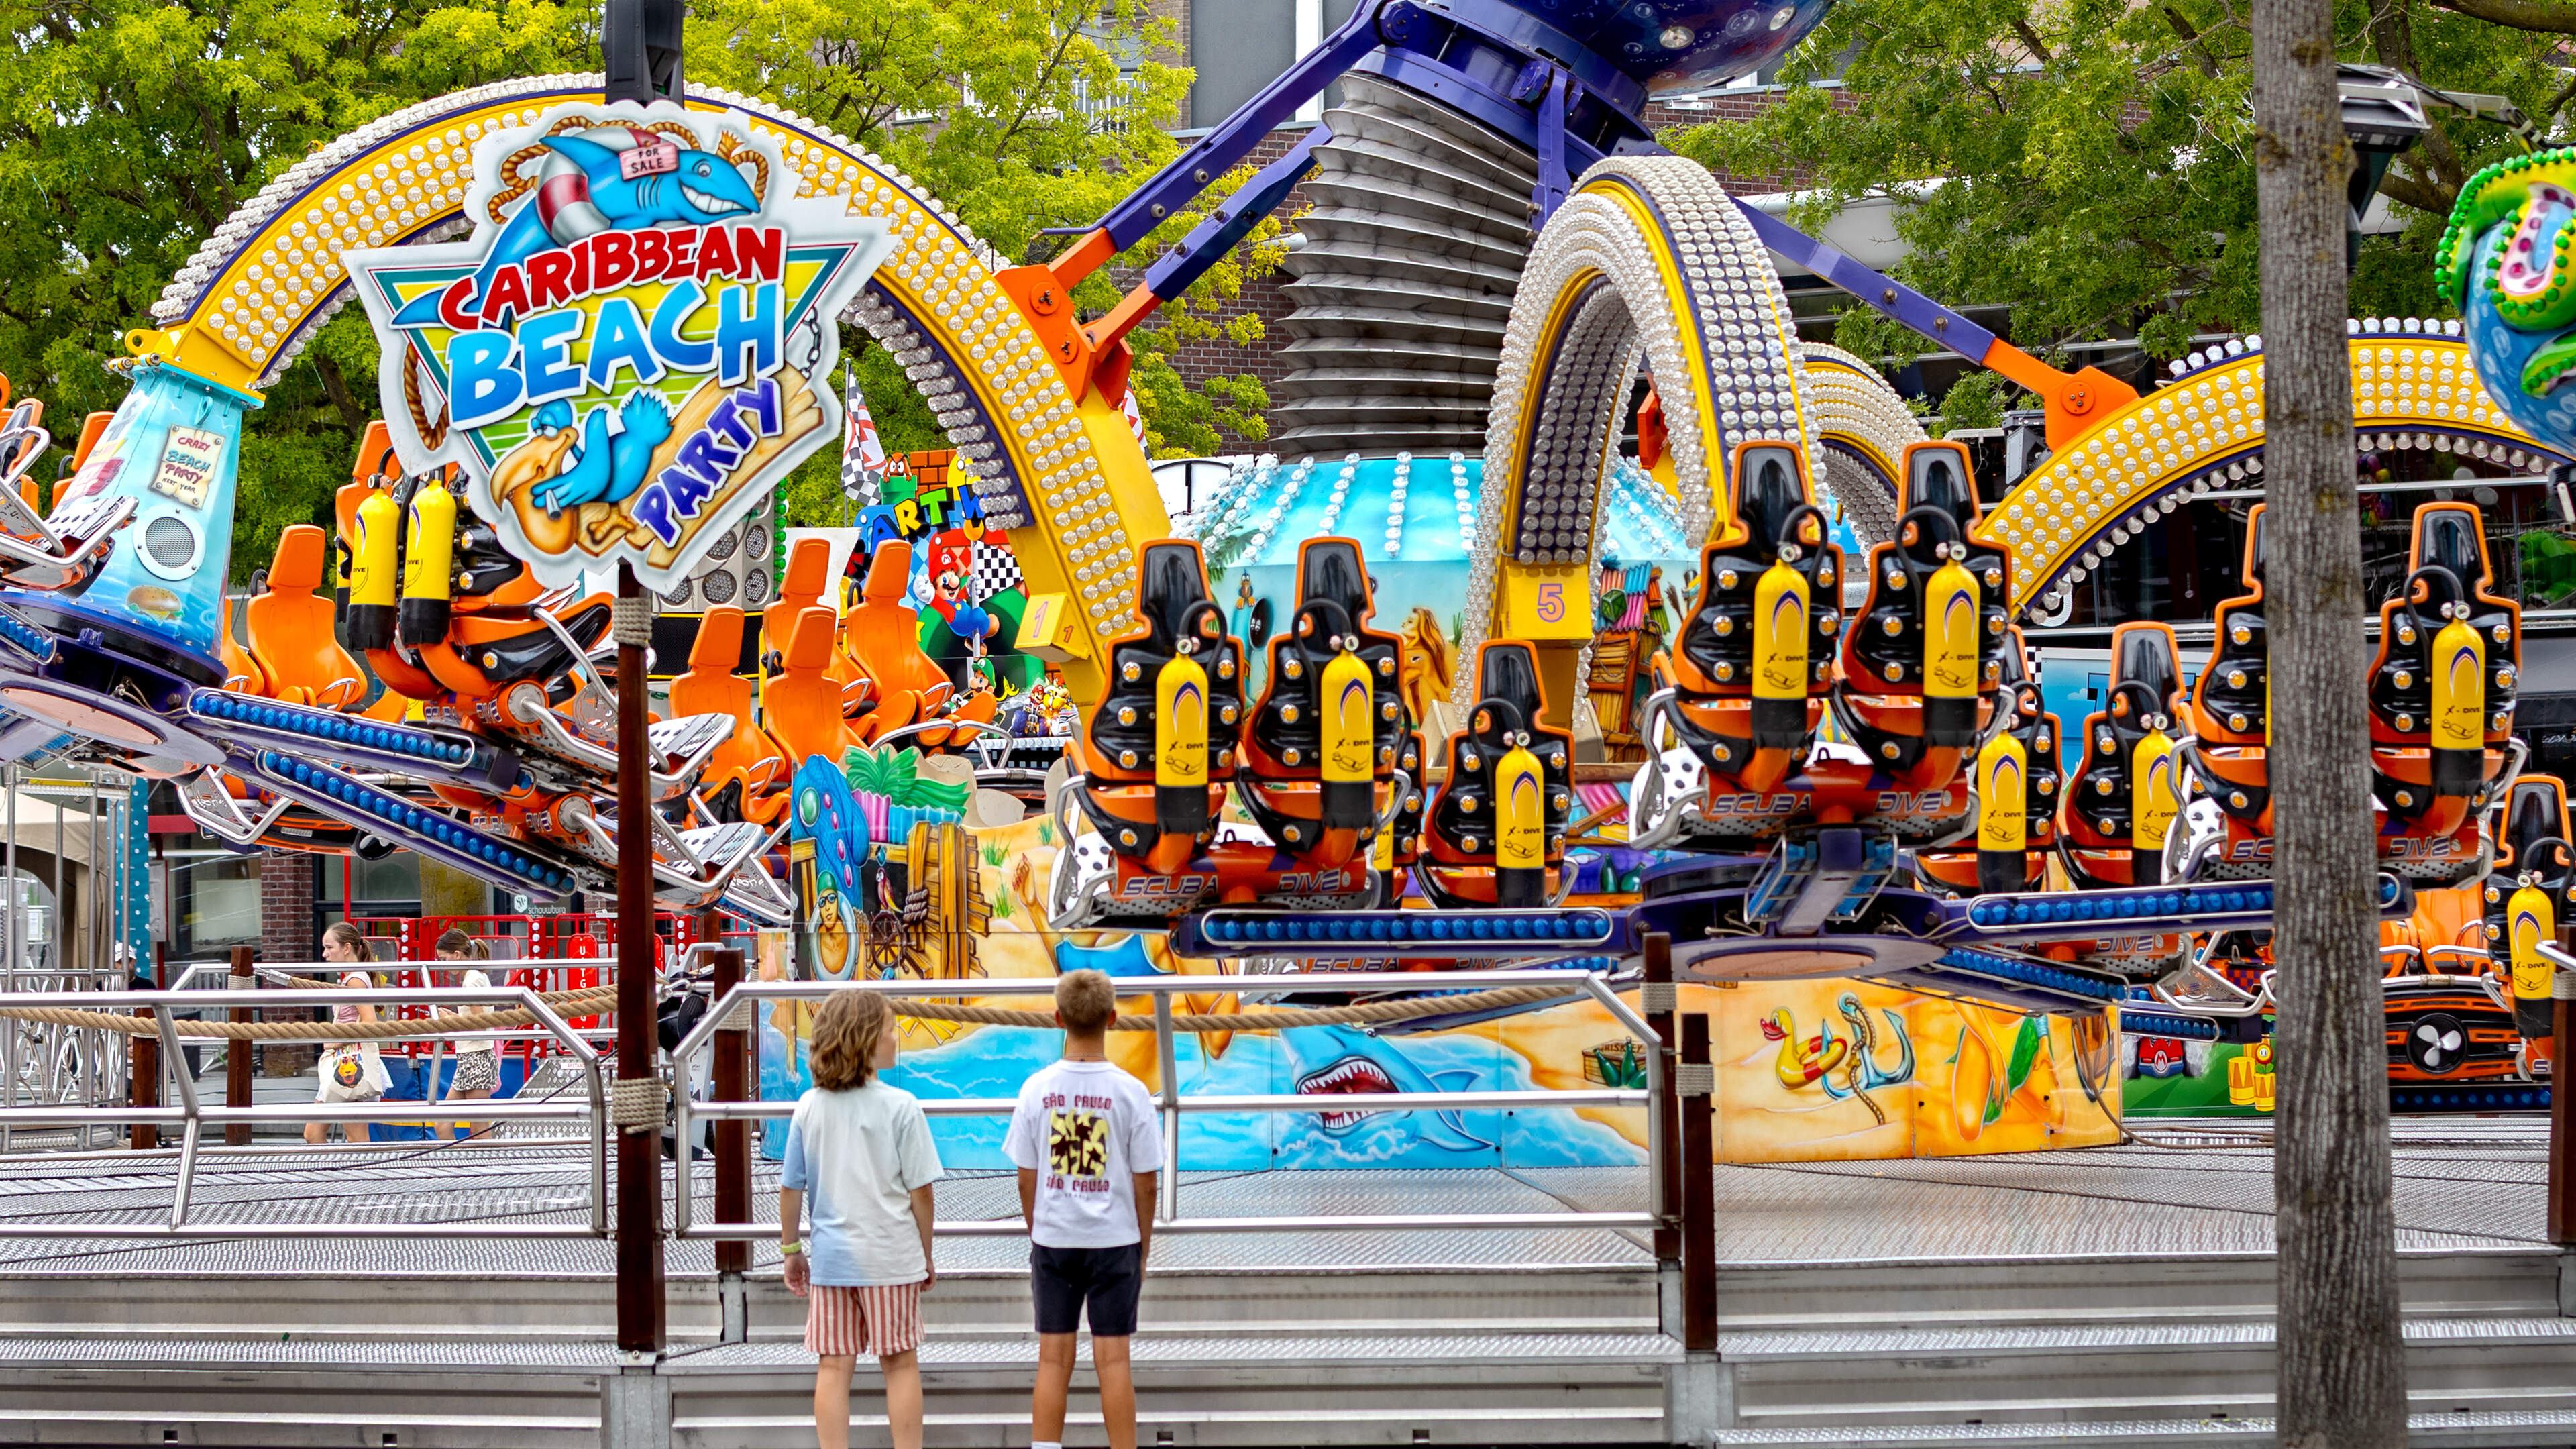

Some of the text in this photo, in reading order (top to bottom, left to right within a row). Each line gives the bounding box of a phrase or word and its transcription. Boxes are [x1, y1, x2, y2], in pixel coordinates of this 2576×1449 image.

[639, 148, 659, 158] FOR
[631, 158, 664, 174] SALE
[439, 227, 784, 331] CARIBBEAN
[448, 282, 779, 423] BEACH
[178, 437, 210, 451] CRAZY
[166, 450, 211, 472] BEACH
[633, 379, 782, 543] PARTY
[165, 464, 203, 484] PARTY
[180, 484, 196, 494] YEAR
[1537, 583, 1565, 623] 5
[1033, 601, 1049, 638] 1
[1063, 625, 1073, 643] 1
[1712, 790, 1944, 814] SCUBA DIVE
[2388, 837, 2451, 858] DIVE
[1122, 869, 1341, 896] SCUBA DIVE
[2094, 935, 2153, 953] DIVE
[1311, 957, 1399, 973] SCUBA
